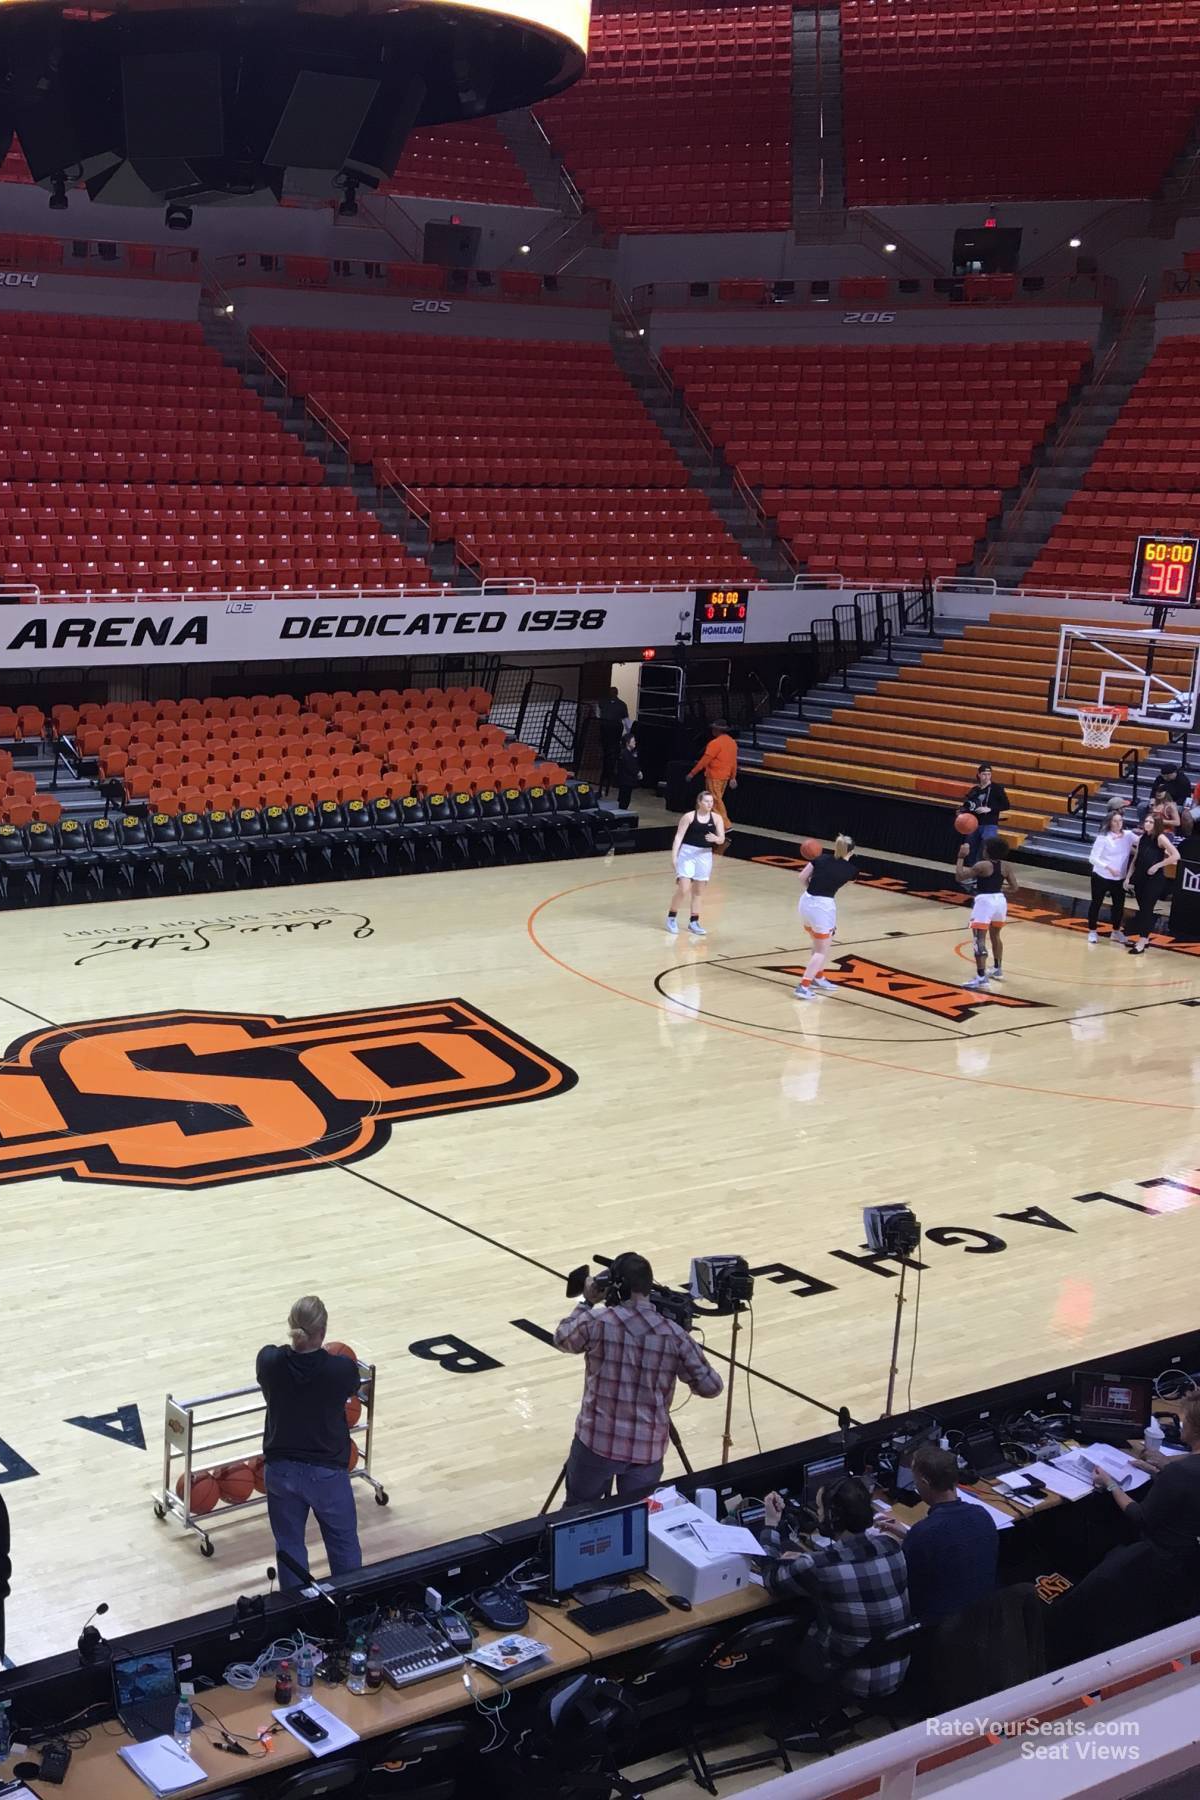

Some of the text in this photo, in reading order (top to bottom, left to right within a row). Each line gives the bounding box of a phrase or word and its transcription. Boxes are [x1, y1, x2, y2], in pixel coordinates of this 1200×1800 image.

[411, 299, 452, 314] 205
[842, 311, 896, 324] 206
[1145, 543, 1193, 563] 60:00
[1148, 563, 1184, 594] 30
[225, 602, 256, 614] 103
[280, 609, 608, 639] DEDICATED 1938
[702, 626, 743, 635] HOMELAND
[7, 619, 208, 650] ARENA
[266, 906, 341, 919] EDDIE
[63, 925, 149, 938] COURT
